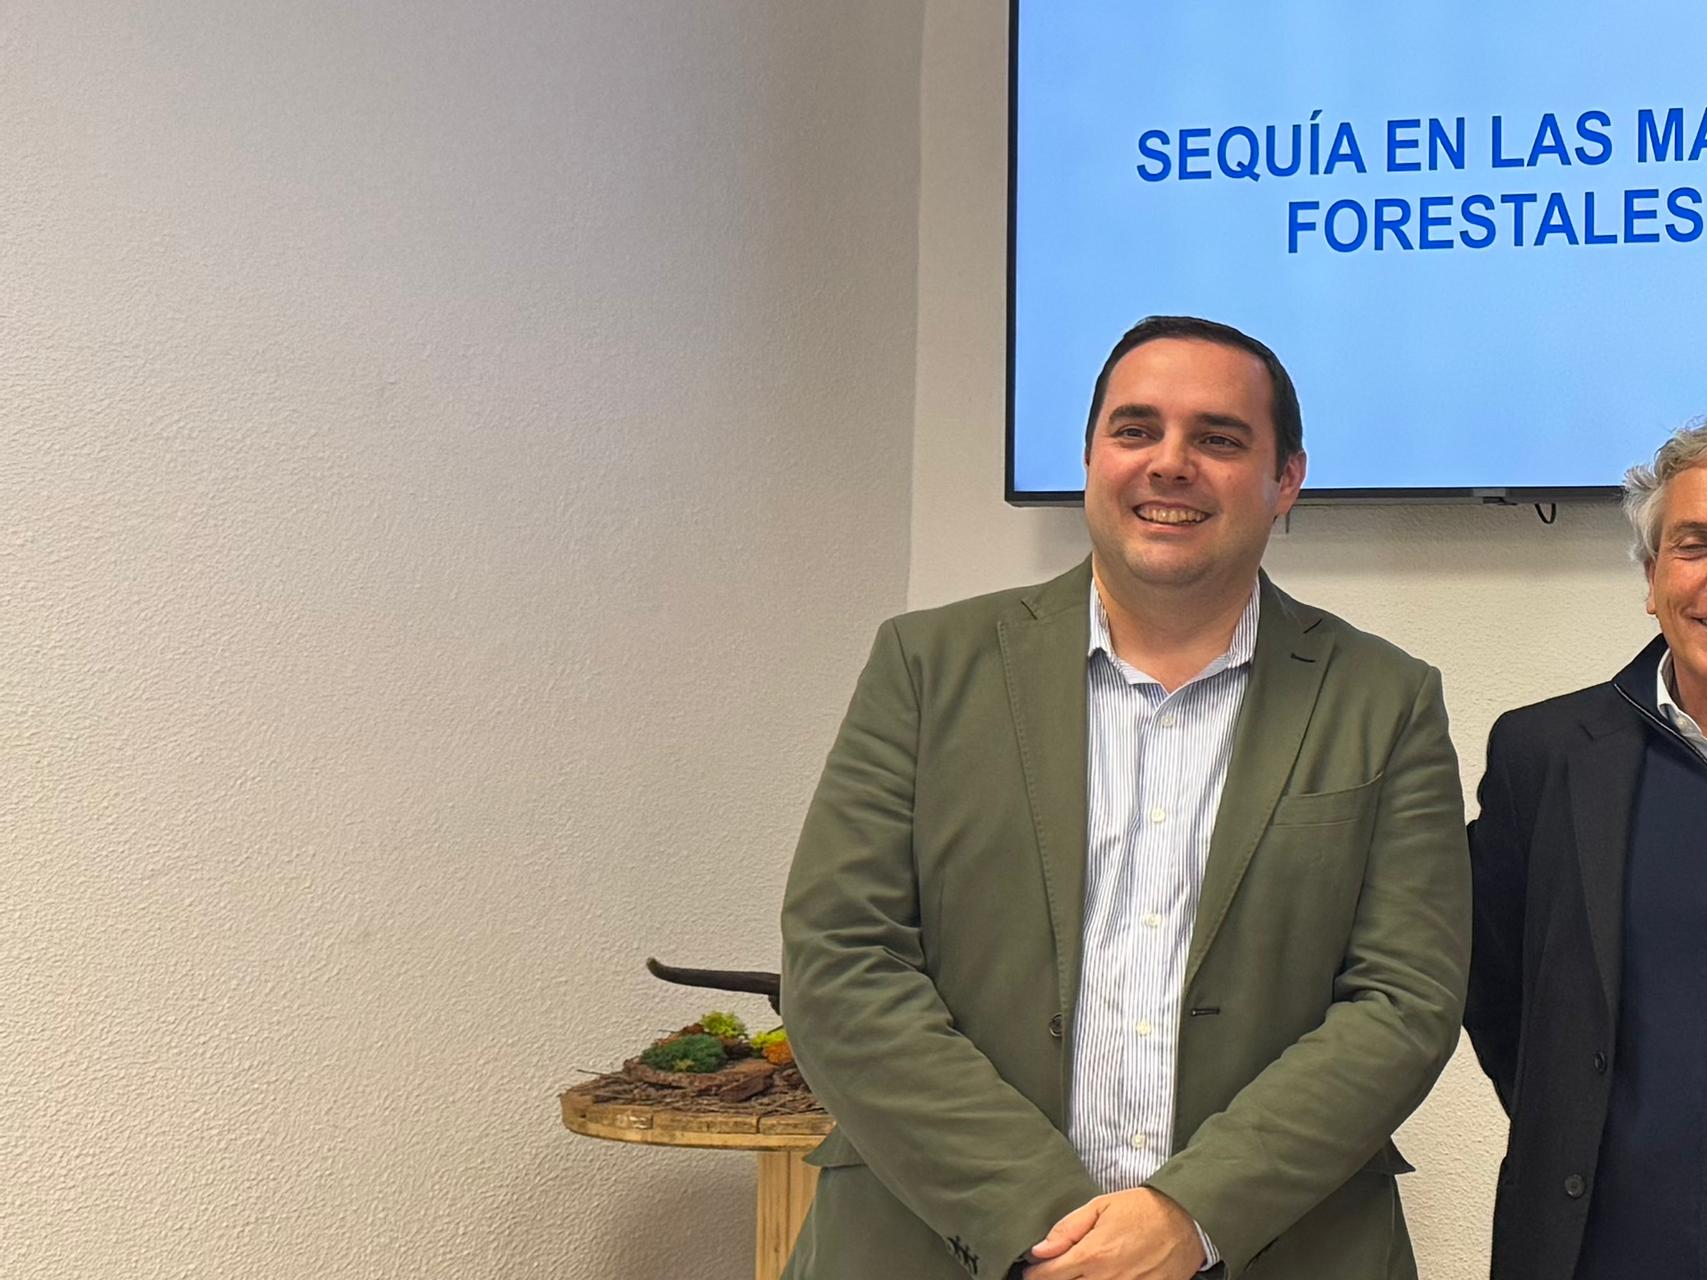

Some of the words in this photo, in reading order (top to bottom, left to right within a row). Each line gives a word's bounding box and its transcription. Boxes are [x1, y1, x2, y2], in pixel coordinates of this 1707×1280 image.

[1136, 109, 1367, 182] SEQUÍA
[1386, 117, 1465, 172] EN
[1491, 110, 1613, 168] LAS
[1288, 187, 1704, 253] FORESTALES
